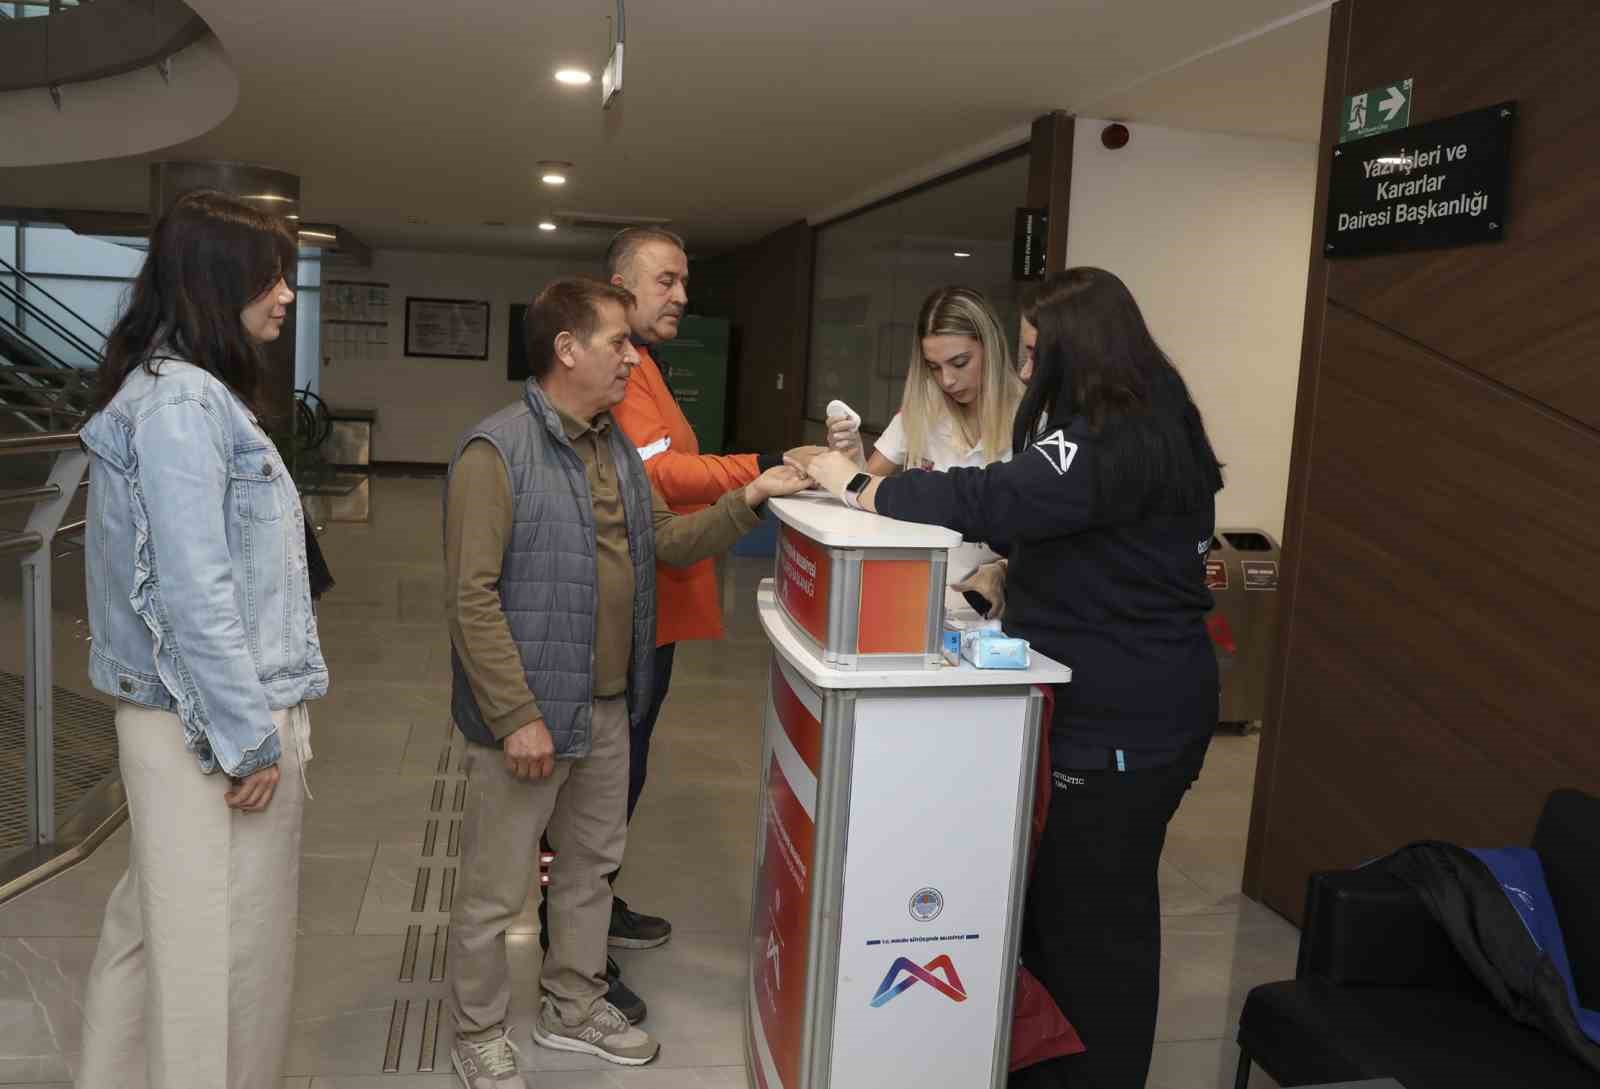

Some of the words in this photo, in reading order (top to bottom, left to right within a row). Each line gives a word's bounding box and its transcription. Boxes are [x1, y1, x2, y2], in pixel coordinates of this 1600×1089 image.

[1362, 158, 1396, 179] Yazı
[1400, 145, 1441, 175] İşleri
[1446, 143, 1468, 162] ve
[1376, 174, 1446, 201] Kararlar
[1338, 206, 1391, 231] Dairesi
[1395, 191, 1489, 225] Başkanlığı
